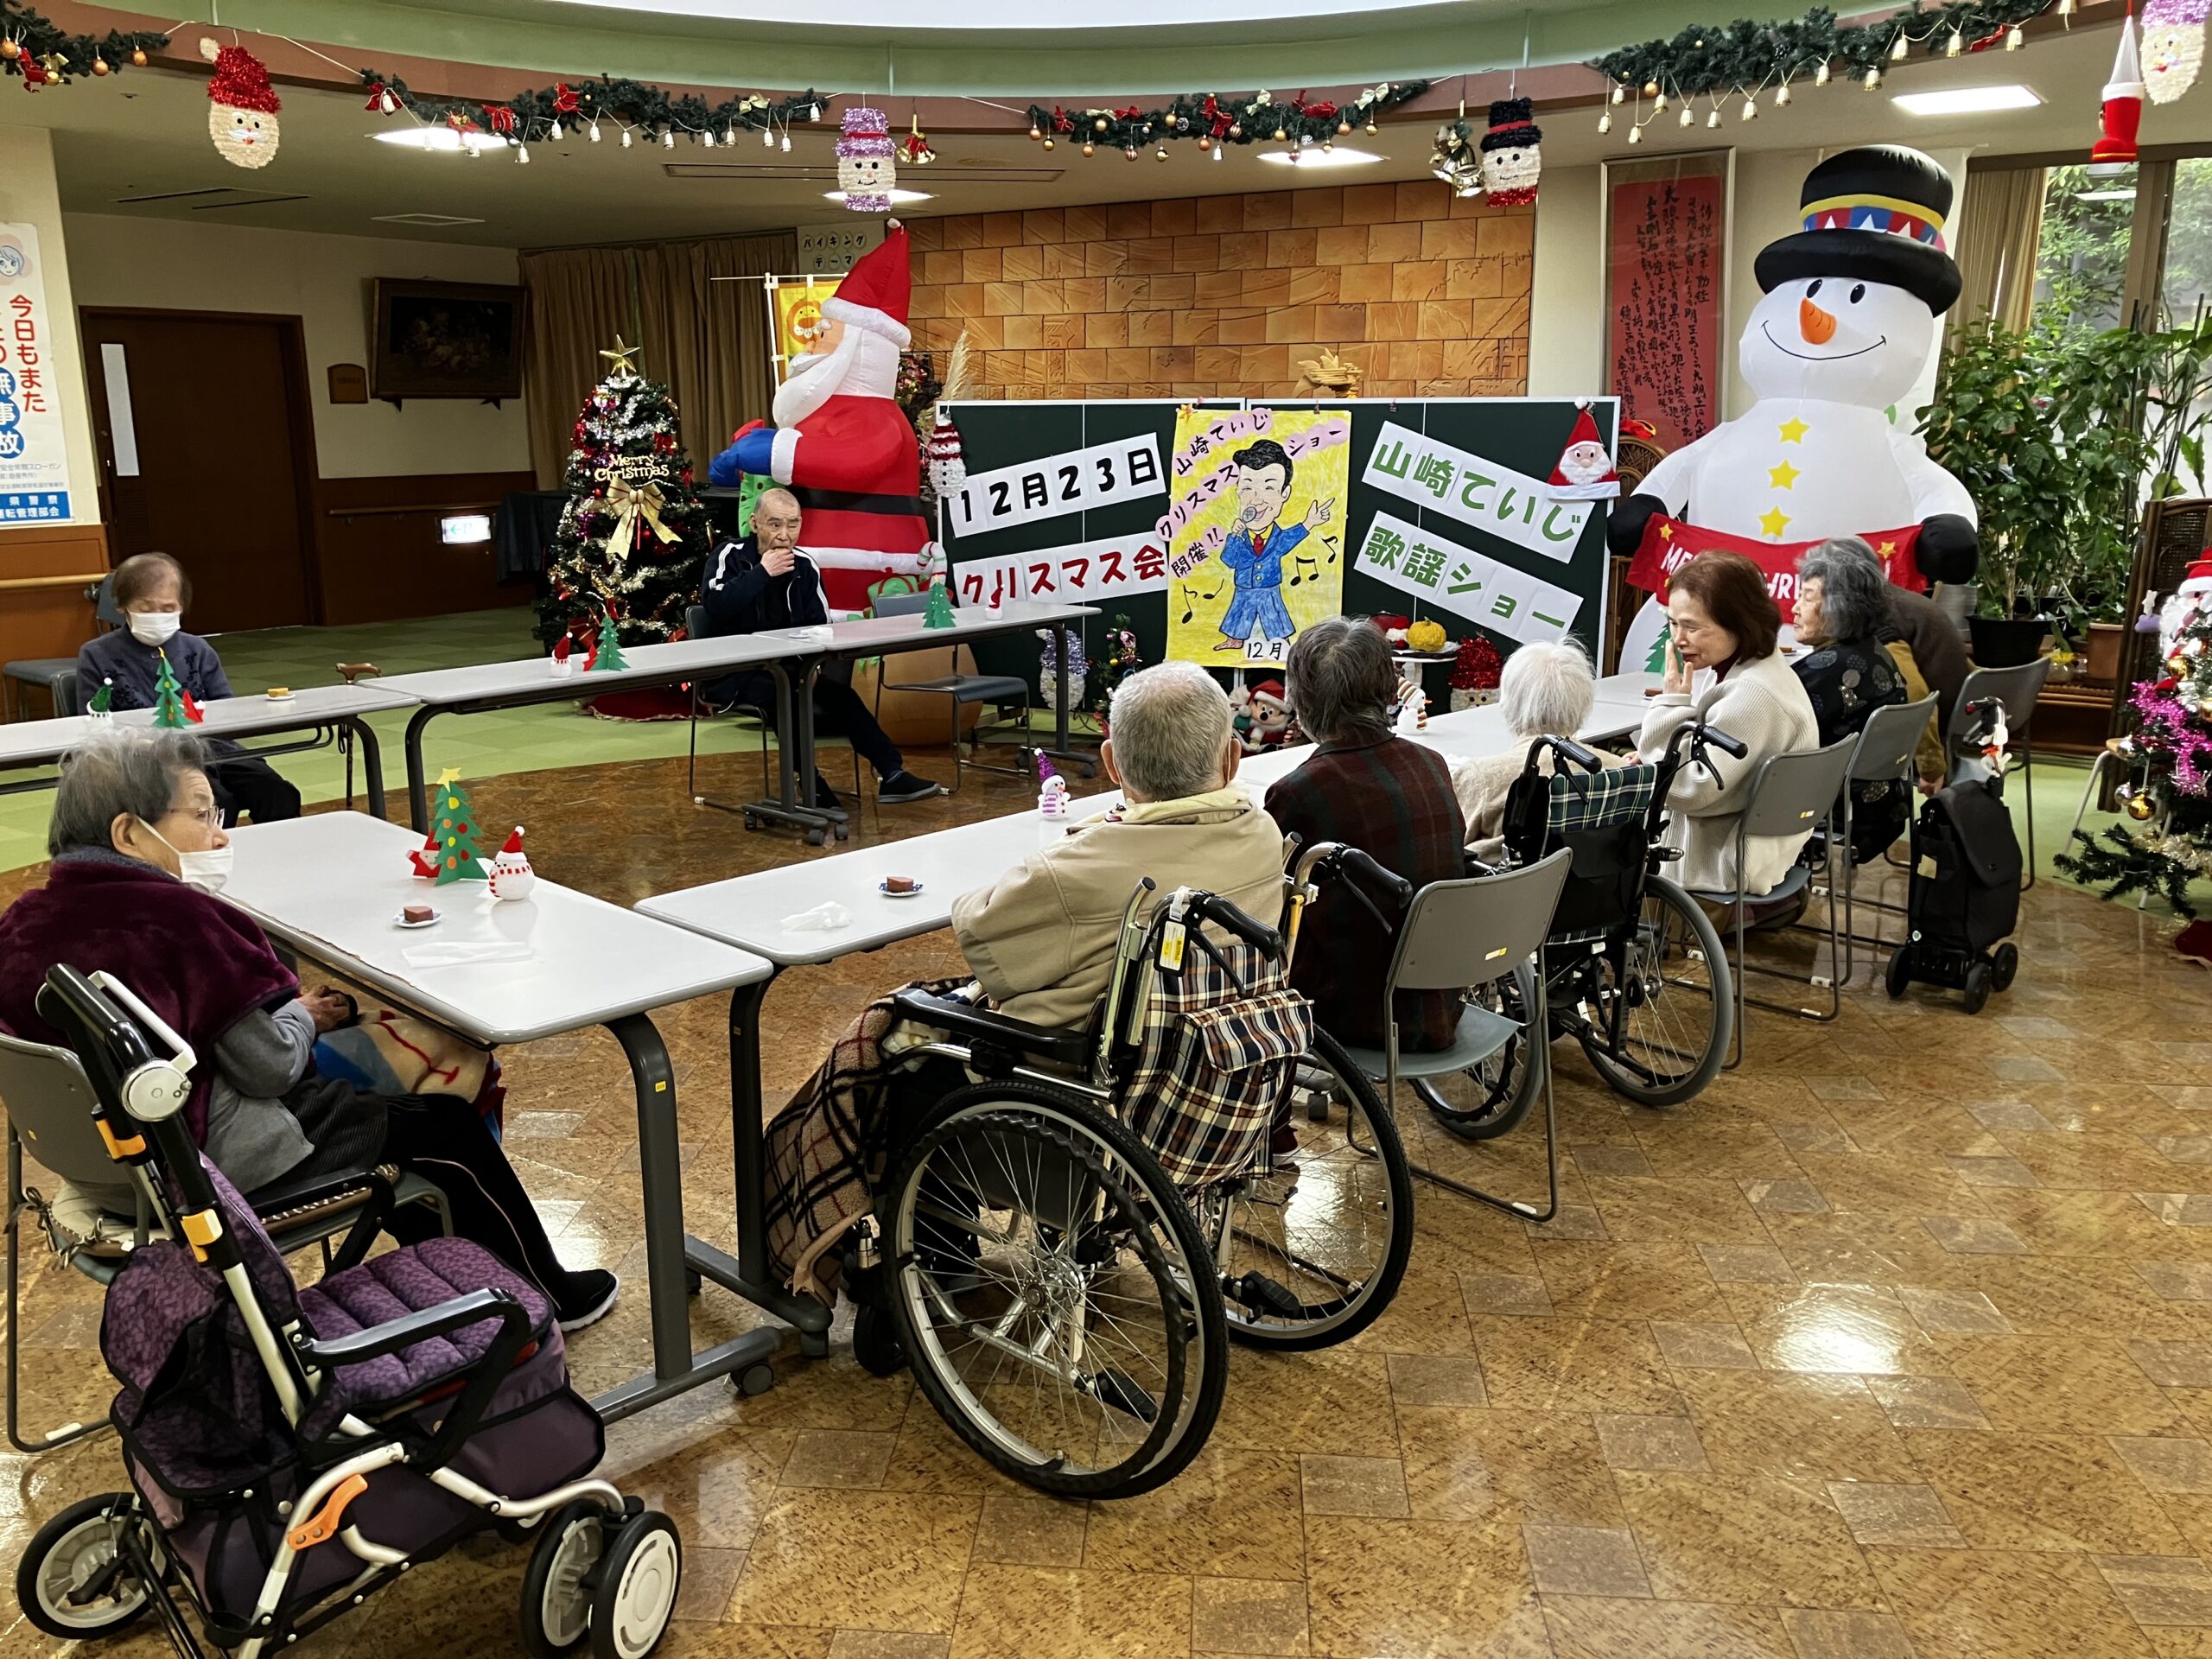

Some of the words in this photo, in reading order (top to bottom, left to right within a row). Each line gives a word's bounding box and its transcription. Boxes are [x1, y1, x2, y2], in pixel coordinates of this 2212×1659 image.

[804, 235, 865, 249] バイキング
[815, 255, 853, 268] テーマ
[10, 295, 47, 412] 今日もまた
[594, 465, 670, 481] Christmas
[608, 453, 654, 467] Merry
[1175, 413, 1269, 477] 山崎ていじ
[961, 448, 1158, 523] 12月23日
[1160, 464, 1239, 539] クリスマス
[1287, 429, 1343, 457] ショー
[1372, 441, 1581, 542] 山崎ていじ
[963, 544, 1166, 604] クリスマス会
[1364, 526, 1566, 628] 歌謡ショー
[1247, 642, 1283, 660] 12月
